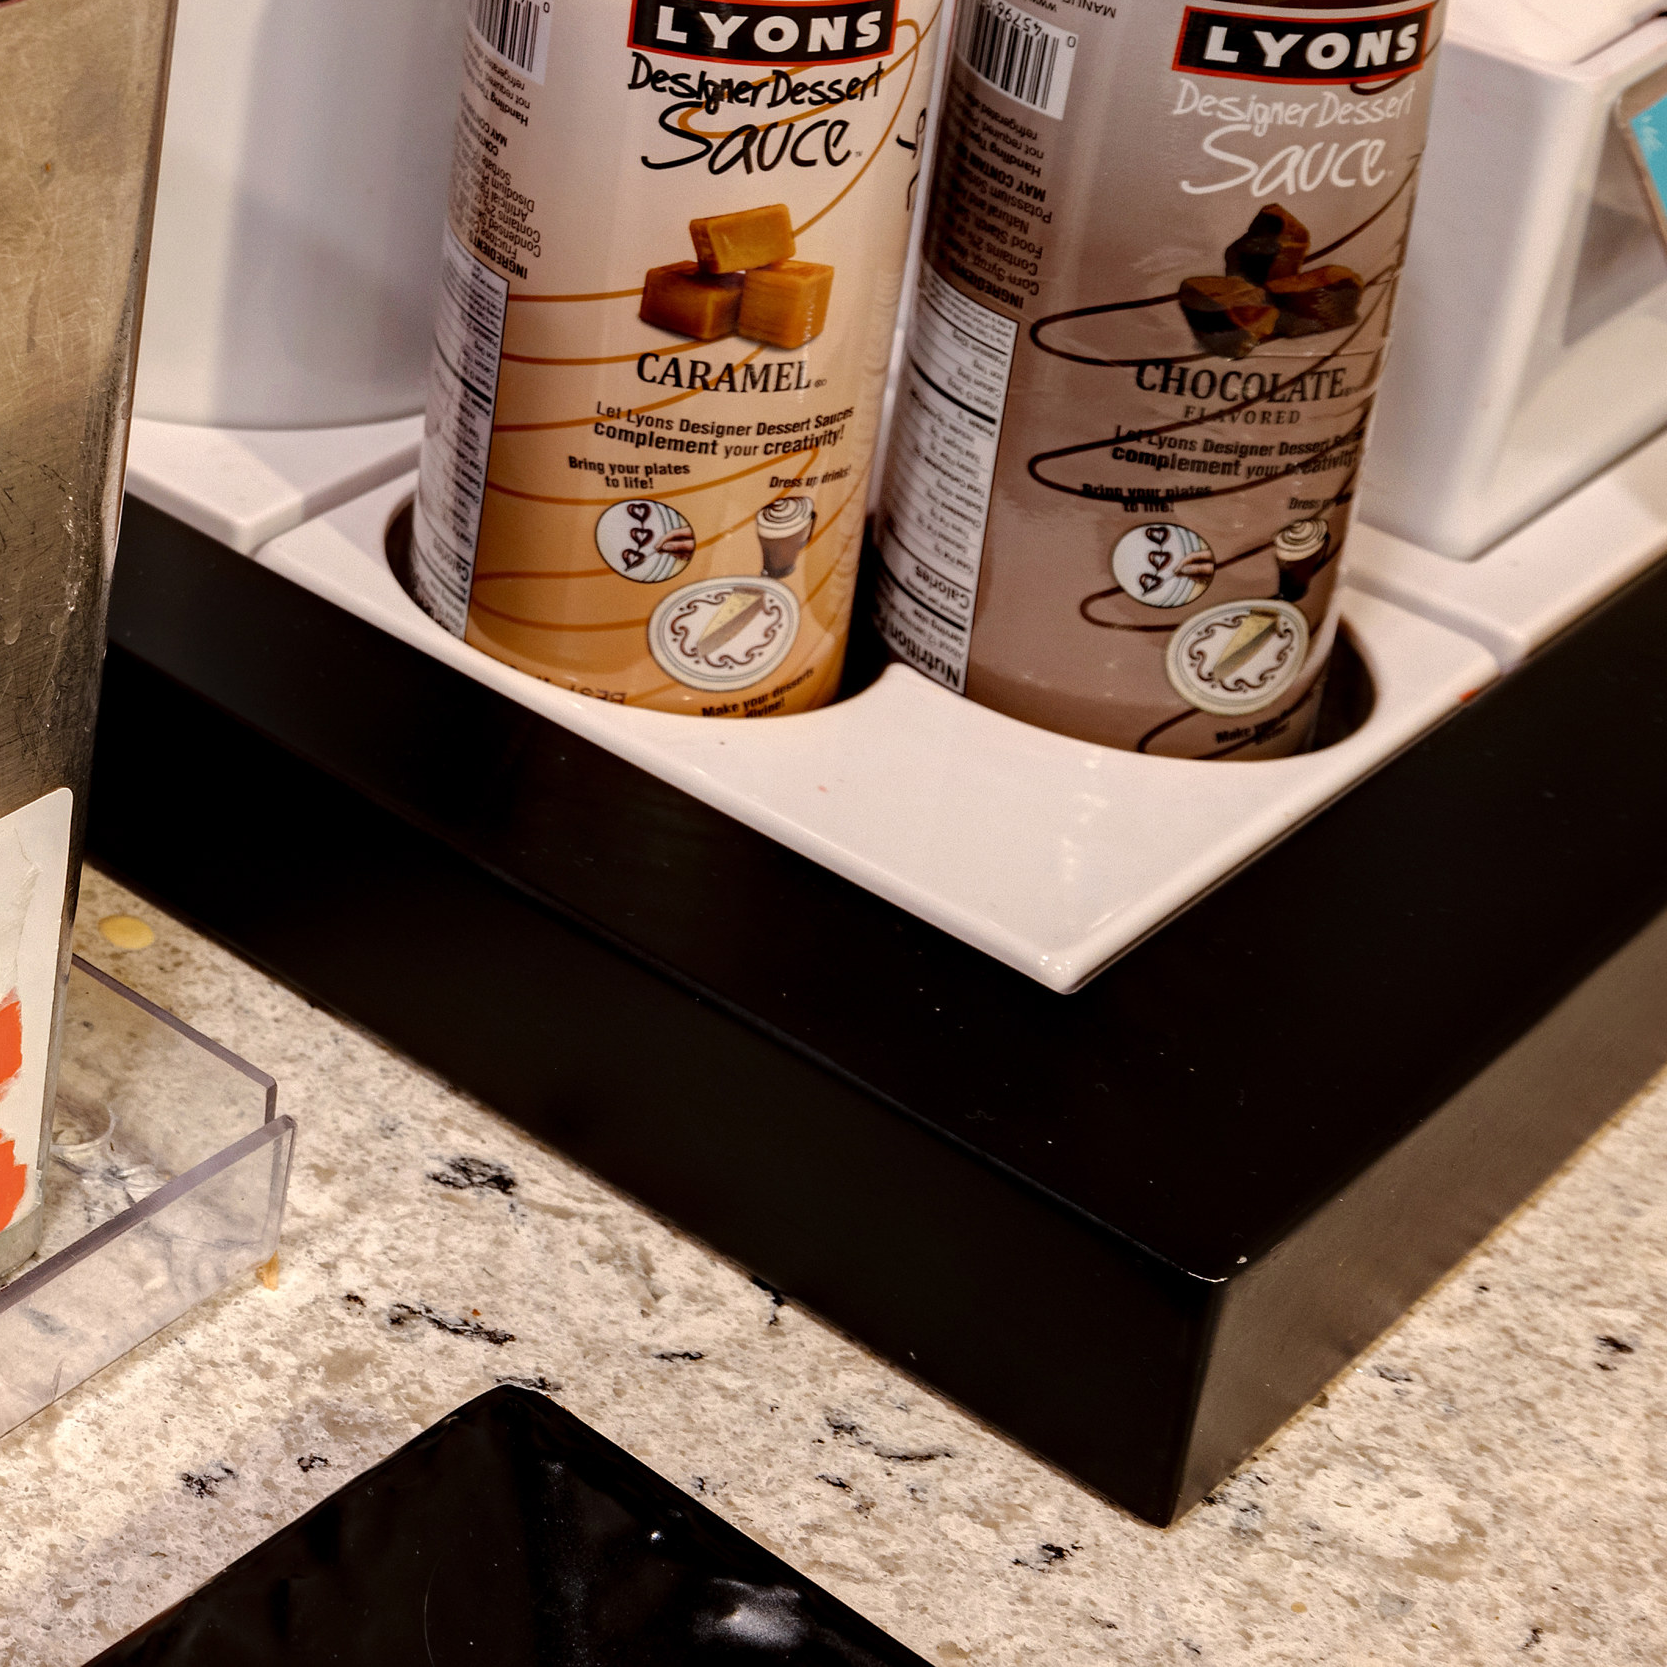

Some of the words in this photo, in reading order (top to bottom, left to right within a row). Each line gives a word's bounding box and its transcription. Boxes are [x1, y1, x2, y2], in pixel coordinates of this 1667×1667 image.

[543, 2, 551, 13] 0
[997, 1, 1043, 36] 45796
[656, 5, 882, 53] LYONS
[1067, 36, 1077, 48] 0
[1204, 23, 1419, 71] LYONS
[628, 51, 770, 115] Designer
[767, 60, 885, 109] Dessert
[490, 91, 529, 127] Handling
[515, 95, 531, 110] not
[1171, 77, 1319, 137] Designer
[1315, 79, 1417, 129] Dessert
[641, 101, 853, 175] Sauce
[1023, 144, 1045, 161] not
[988, 142, 1042, 179] Handling
[1180, 123, 1387, 197] Sauce
[490, 177, 535, 213] Disodium
[989, 186, 1053, 225] Potassium
[1015, 180, 1047, 203] MAY
[497, 210, 541, 243] Contains
[987, 204, 1030, 236] Natural
[488, 218, 542, 258] Condensed
[1011, 235, 1044, 260] Food
[985, 242, 1039, 277] Contains
[1008, 273, 1040, 297] Corn
[636, 352, 811, 393] CARAMEL
[1133, 360, 1347, 403] CHOCOLATE
[596, 401, 622, 420] Let
[627, 412, 674, 432] Lyons
[678, 418, 752, 439] Designer
[756, 419, 810, 437] Dessert
[813, 406, 855, 430] Sauces
[1183, 404, 1302, 426] FLAVORED
[593, 422, 719, 456] complement
[723, 443, 759, 459] your
[763, 424, 846, 455] creativity!
[1148, 434, 1199, 452] Lyons
[1202, 438, 1276, 457] Designer
[568, 455, 606, 475] Bring
[608, 464, 642, 478] your
[644, 462, 691, 477] plates
[1111, 446, 1242, 477] complement
[1247, 463, 1281, 480] your
[605, 475, 621, 488] to
[622, 475, 654, 490] life!
[768, 475, 804, 490] Dress
[915, 564, 971, 611] Calories
[929, 619, 966, 648] Serving
[887, 624, 961, 688] Nutrition
[700, 703, 740, 718] Make
[742, 692, 770, 710] your
